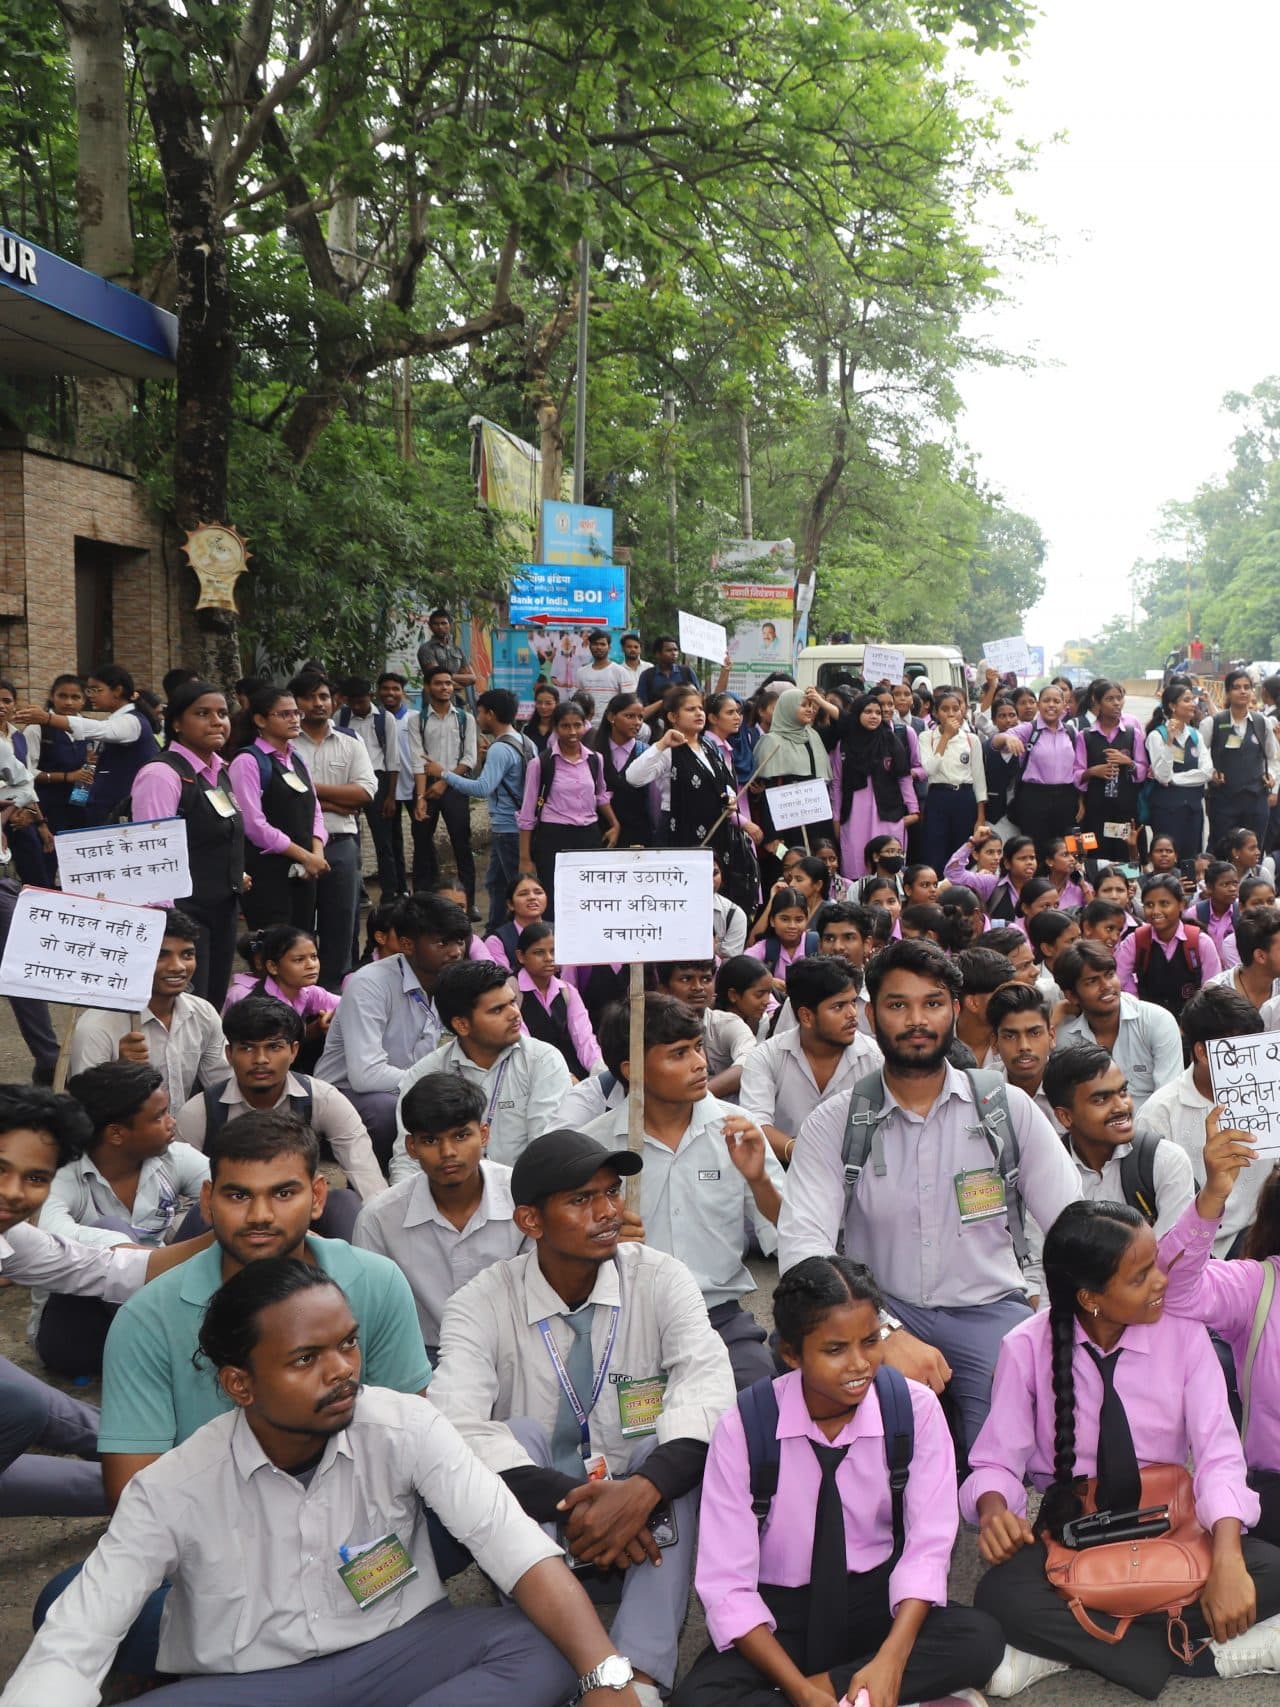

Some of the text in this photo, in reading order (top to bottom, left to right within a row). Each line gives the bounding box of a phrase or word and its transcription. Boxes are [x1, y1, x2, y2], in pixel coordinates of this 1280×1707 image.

[510, 595, 569, 606] Bank of India
[573, 590, 602, 603] BOI
[75, 837, 169, 860] पढ़ाई के साथ
[68, 858, 179, 885] मजाक बंद करो!
[579, 866, 689, 887] आवाज़ उठाएंगे,
[579, 894, 688, 912] अपना अधिकार
[29, 906, 55, 921] हम
[105, 919, 134, 938] नहीं
[135, 923, 148, 943] हैं,
[603, 923, 663, 944] बचाएंगे!
[39, 934, 129, 965] जो जहाँ चाहे
[24, 961, 128, 991] ट्रांसफर कर दो!
[1212, 1039, 1261, 1070] बिना
[1215, 1072, 1276, 1107] कॉलेज
